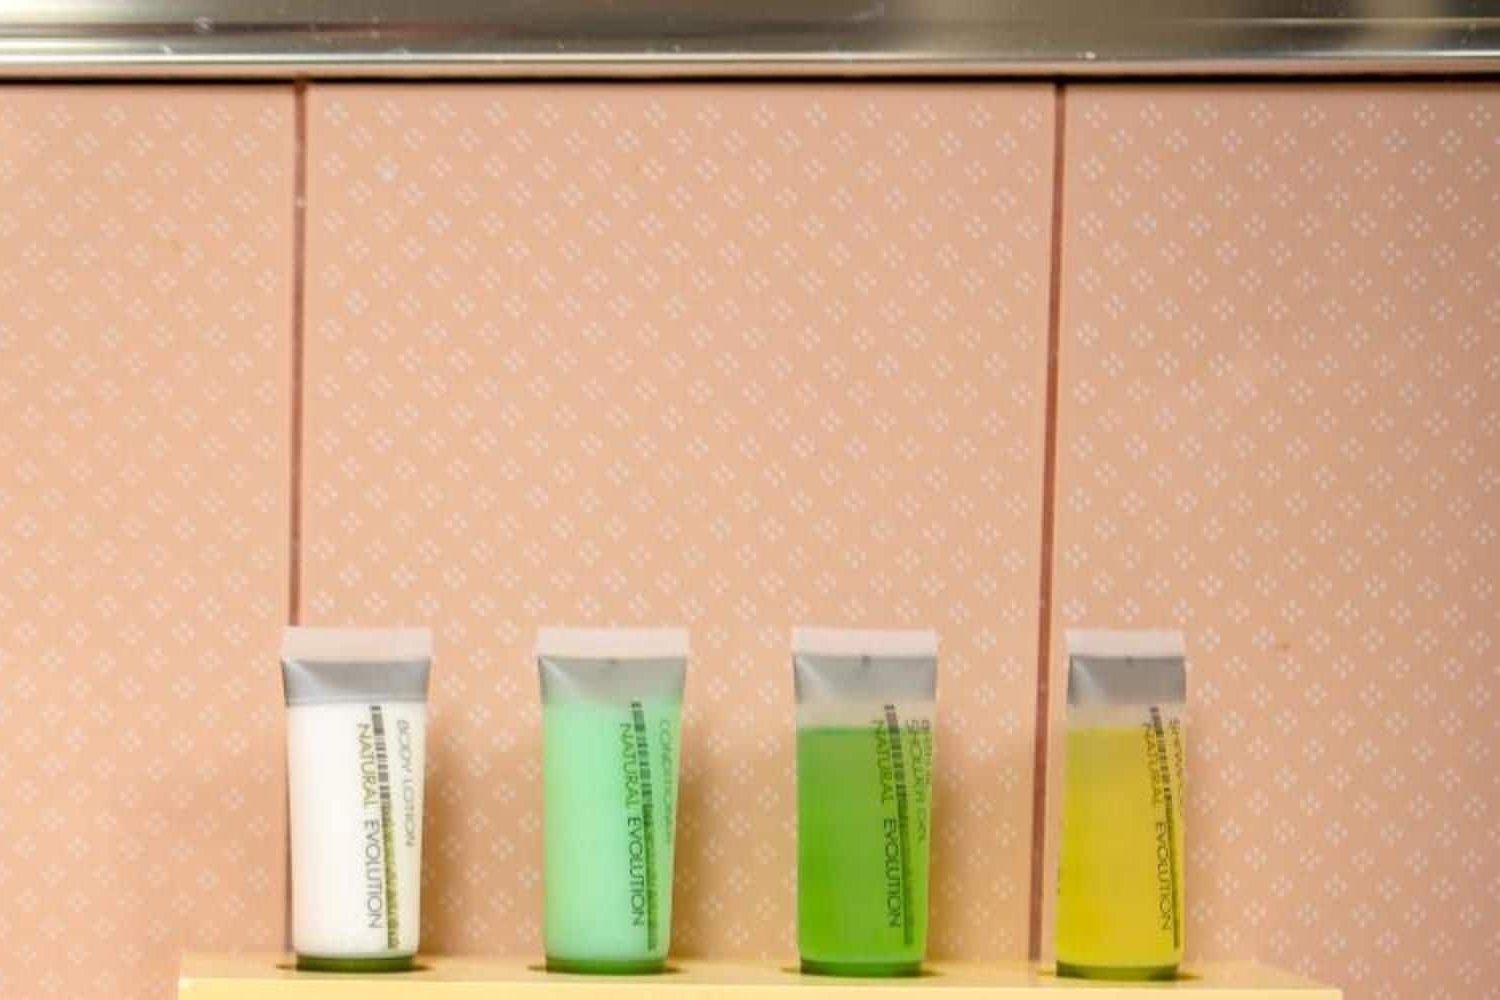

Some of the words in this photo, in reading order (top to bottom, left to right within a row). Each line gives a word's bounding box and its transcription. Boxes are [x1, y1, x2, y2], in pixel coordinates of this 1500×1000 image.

[357, 721, 378, 811] NATURAL
[397, 719, 414, 771] BODY
[620, 722, 641, 811] NATURAL
[871, 719, 896, 806] NATURAL
[401, 778, 418, 848] LOTION
[1141, 721, 1164, 808] NATURAL
[1153, 820, 1173, 932] EVOLUTION
[363, 818, 384, 930] EVOLUTION
[626, 815, 646, 928] EVOLUTION
[883, 817, 903, 929] EVOLUTION
